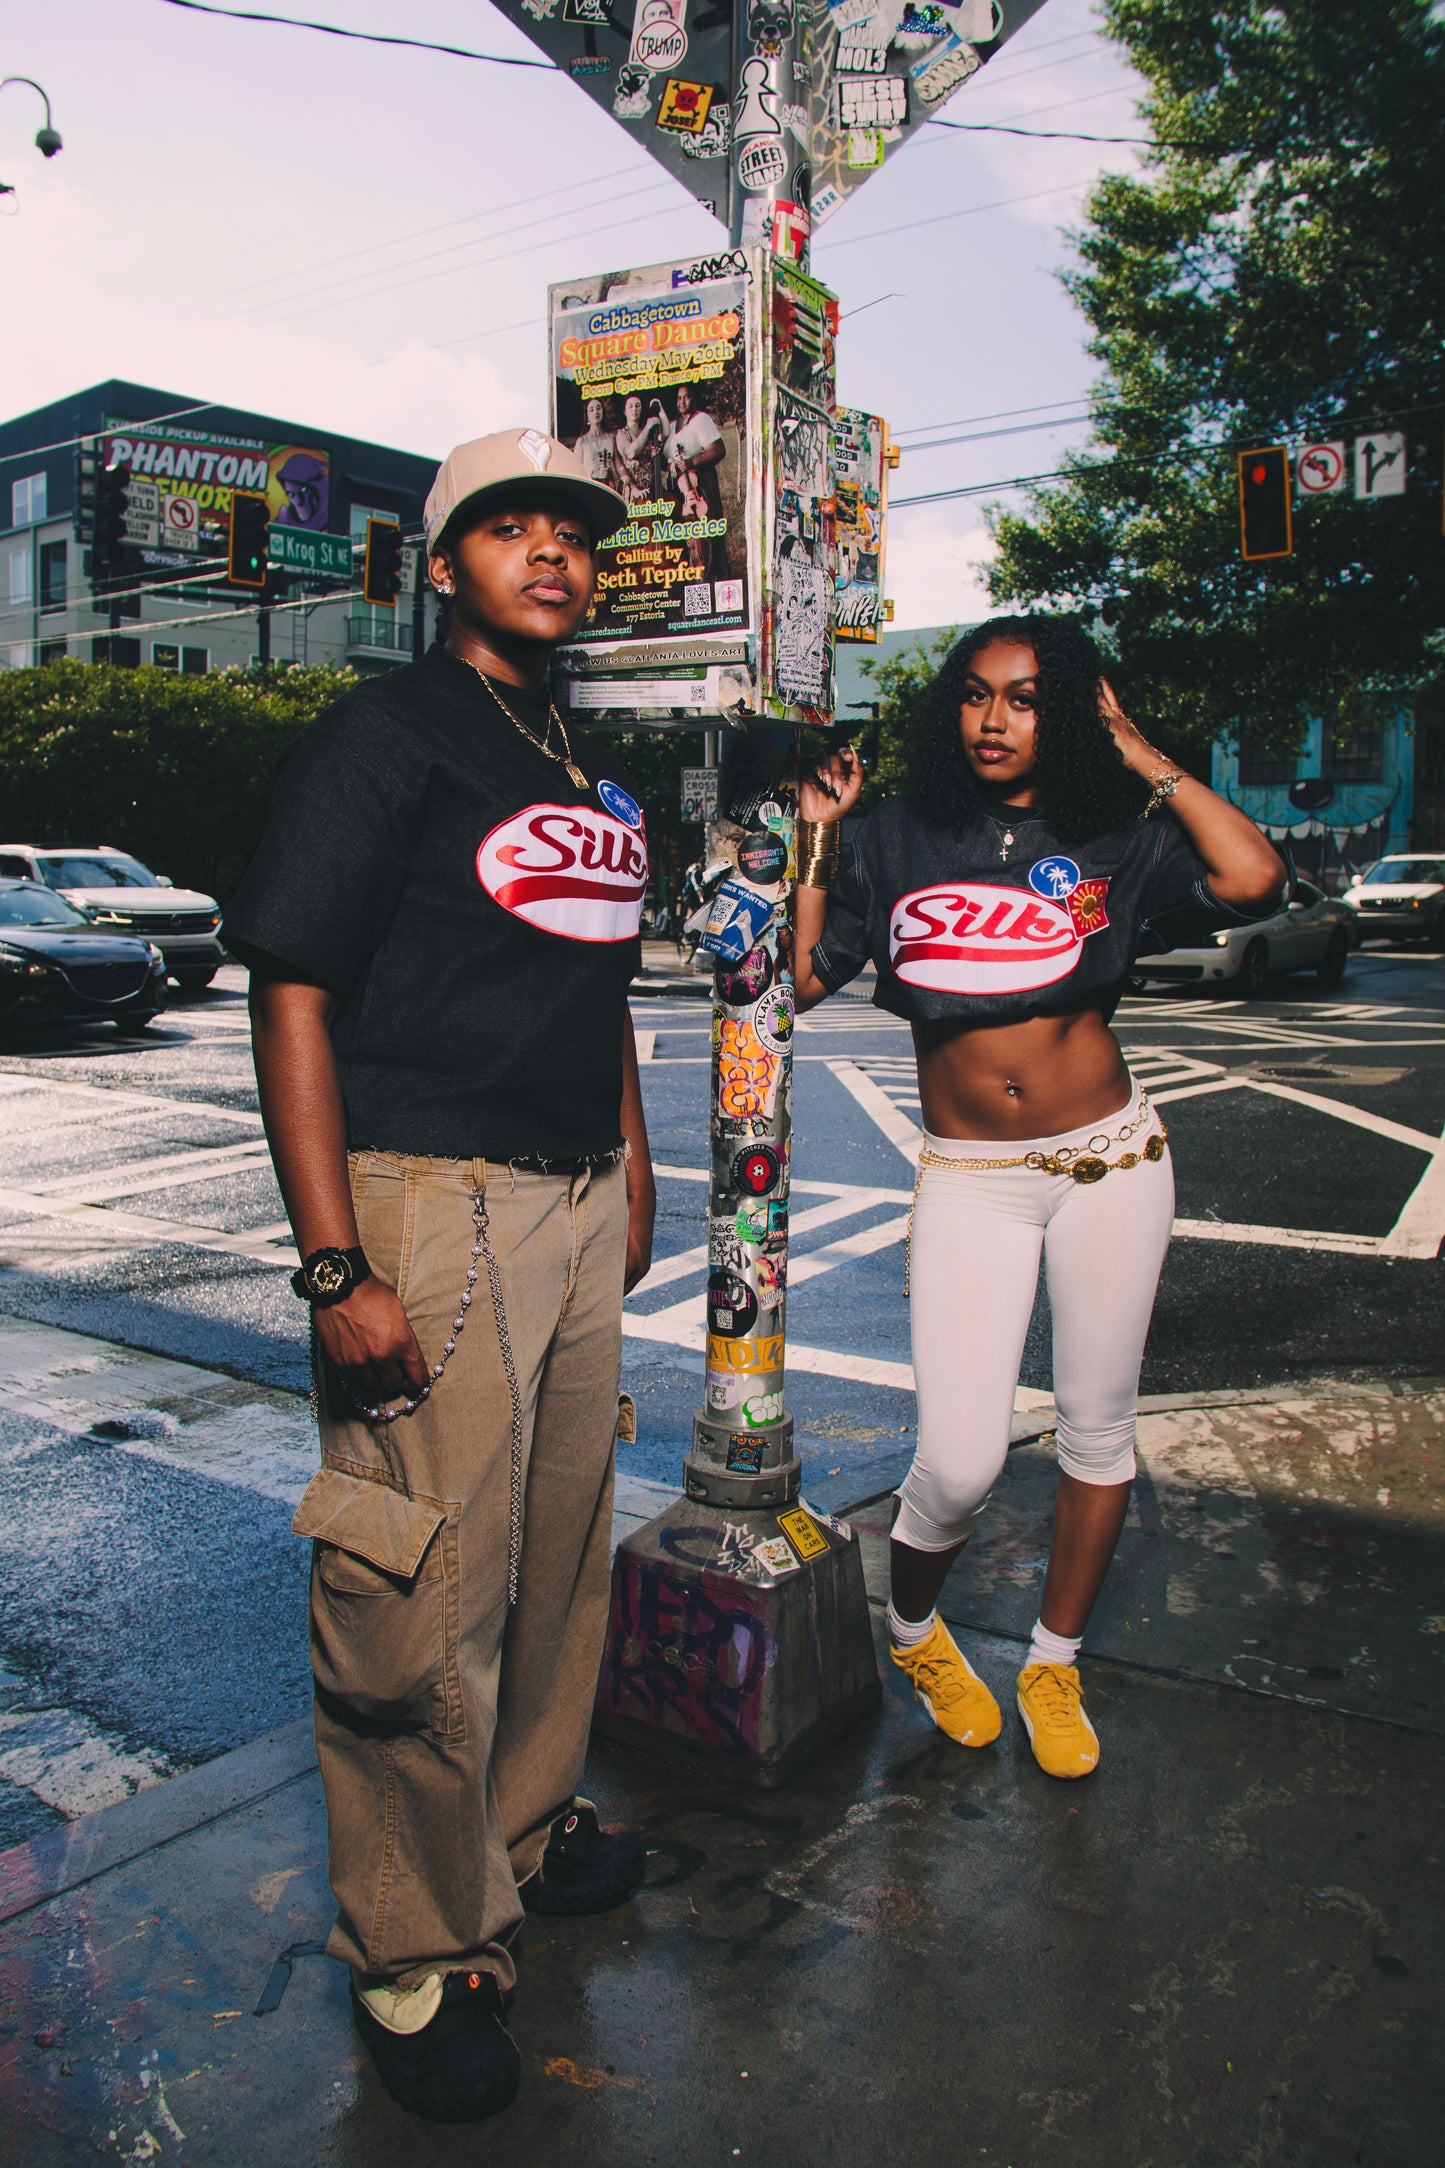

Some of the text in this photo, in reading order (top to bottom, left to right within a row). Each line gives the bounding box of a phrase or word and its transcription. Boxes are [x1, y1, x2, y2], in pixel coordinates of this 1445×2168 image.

[641, 36, 682, 57] TRUMP
[836, 48, 886, 73] MOL3
[663, 113, 698, 128] JOSEF
[740, 147, 782, 174] STREET
[742, 163, 784, 187] VANS
[590, 299, 700, 334] Cabbagetown
[561, 317, 736, 366] Square Dance
[574, 340, 732, 383] Wednesday May 20th
[583, 364, 722, 397] Doors 630 PM Dance 7 PM
[166, 426, 208, 442] PICKUP
[210, 435, 264, 450] AVAILABLE
[110, 438, 269, 490] PHANTOM
[659, 499, 676, 515] by
[128, 520, 150, 531] ELLOW
[652, 516, 728, 543] Mercies
[286, 536, 348, 568] Krog St NE
[616, 545, 684, 565] Calling by
[597, 561, 706, 590] Seth Tepfer
[593, 592, 607, 603] $10
[610, 599, 682, 614] Community Center
[618, 590, 669, 604] Cabbagetown
[626, 611, 666, 623] 177 Estoria
[667, 615, 743, 631] squaredanceatl.com
[603, 657, 618, 666] US
[495, 813, 648, 881] Silk
[741, 847, 785, 861] IMMIGRANTS
[748, 856, 780, 869] WELCOME
[737, 888, 769, 912] WANTED.
[893, 892, 1074, 944] Silk
[757, 994, 778, 1026] PLAYA
[741, 1144, 765, 1156] PITCHES
[791, 1515, 804, 1526] THE
[795, 1524, 811, 1536] WAR
[803, 1533, 814, 1542] ON
[803, 1539, 822, 1552] CARS
